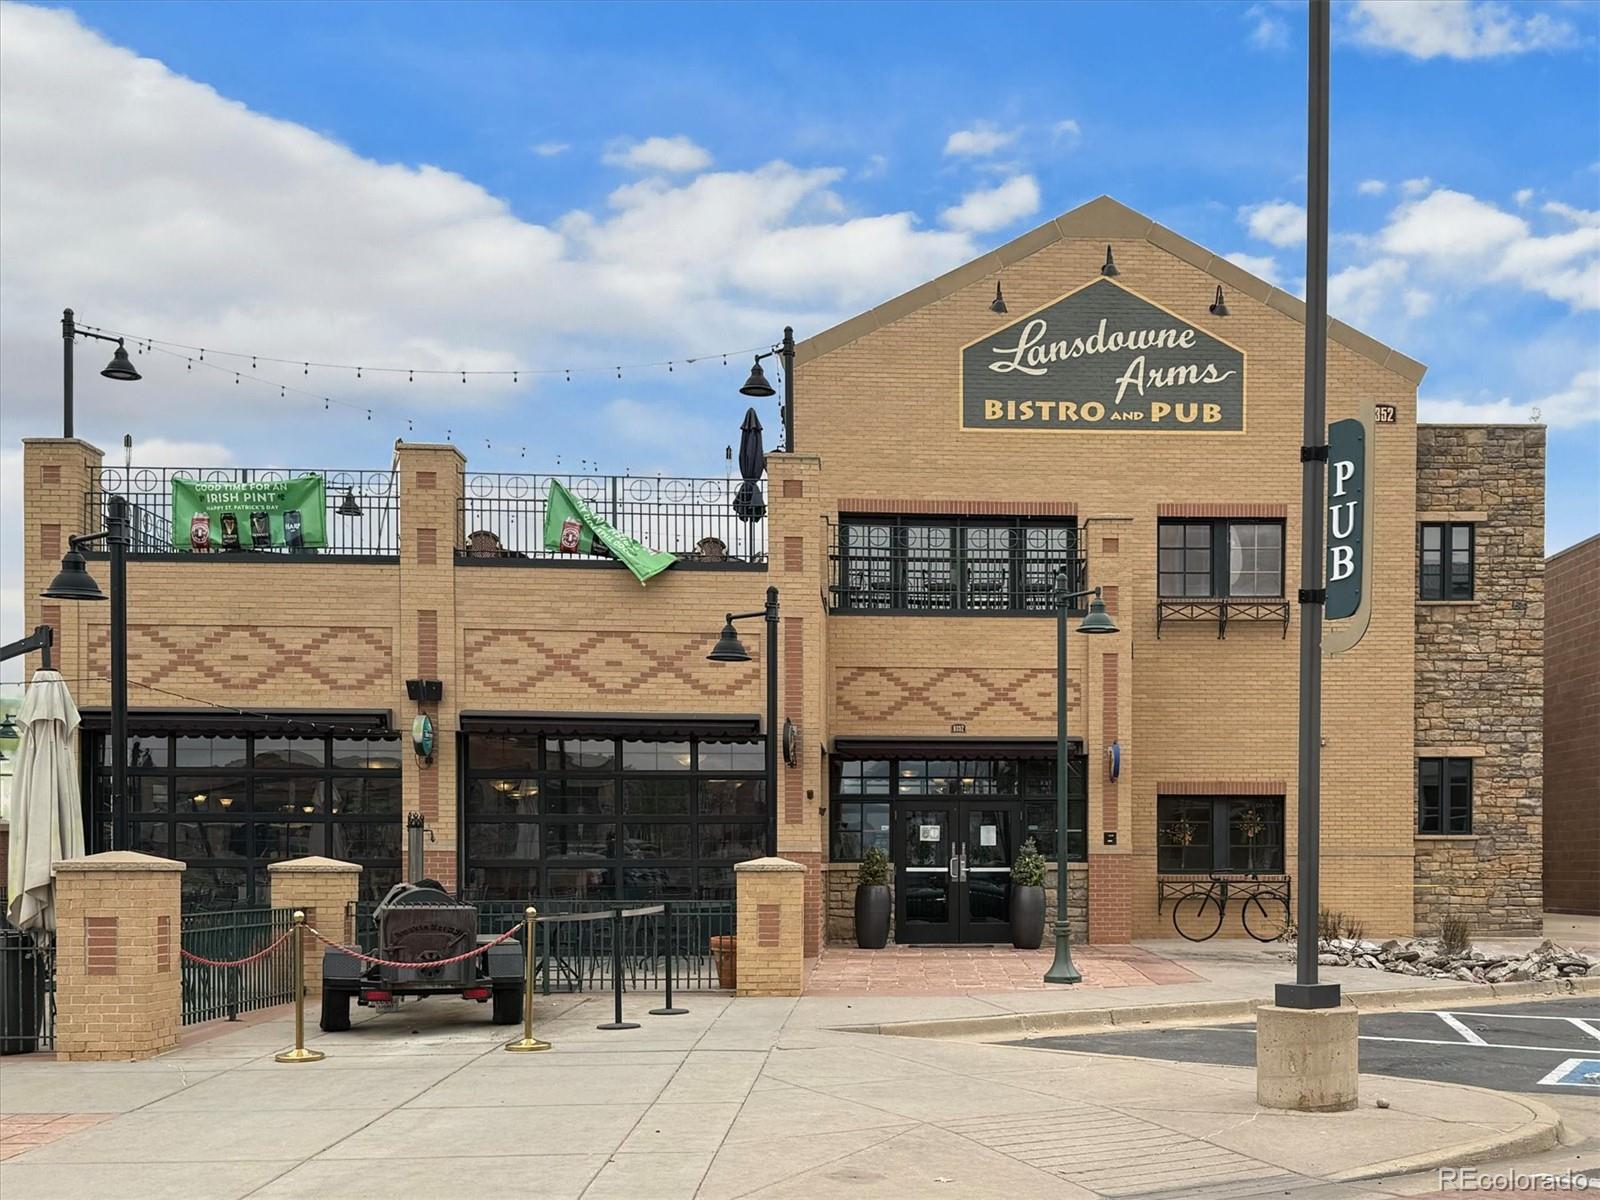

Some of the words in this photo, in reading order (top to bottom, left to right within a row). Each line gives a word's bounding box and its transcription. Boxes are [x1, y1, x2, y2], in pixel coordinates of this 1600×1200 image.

[988, 318, 1197, 376] Lansdowne
[1114, 355, 1237, 405] Arms
[984, 399, 1106, 422] BISTRO
[1110, 411, 1145, 422] AND
[1150, 402, 1223, 423] PUB
[195, 483, 221, 492] GOOD
[223, 483, 247, 491] TIME
[250, 482, 270, 491] FOR
[272, 481, 288, 491] AN
[206, 492, 239, 503] IRISH
[243, 492, 276, 503] PINT
[1329, 460, 1358, 581] PUB
